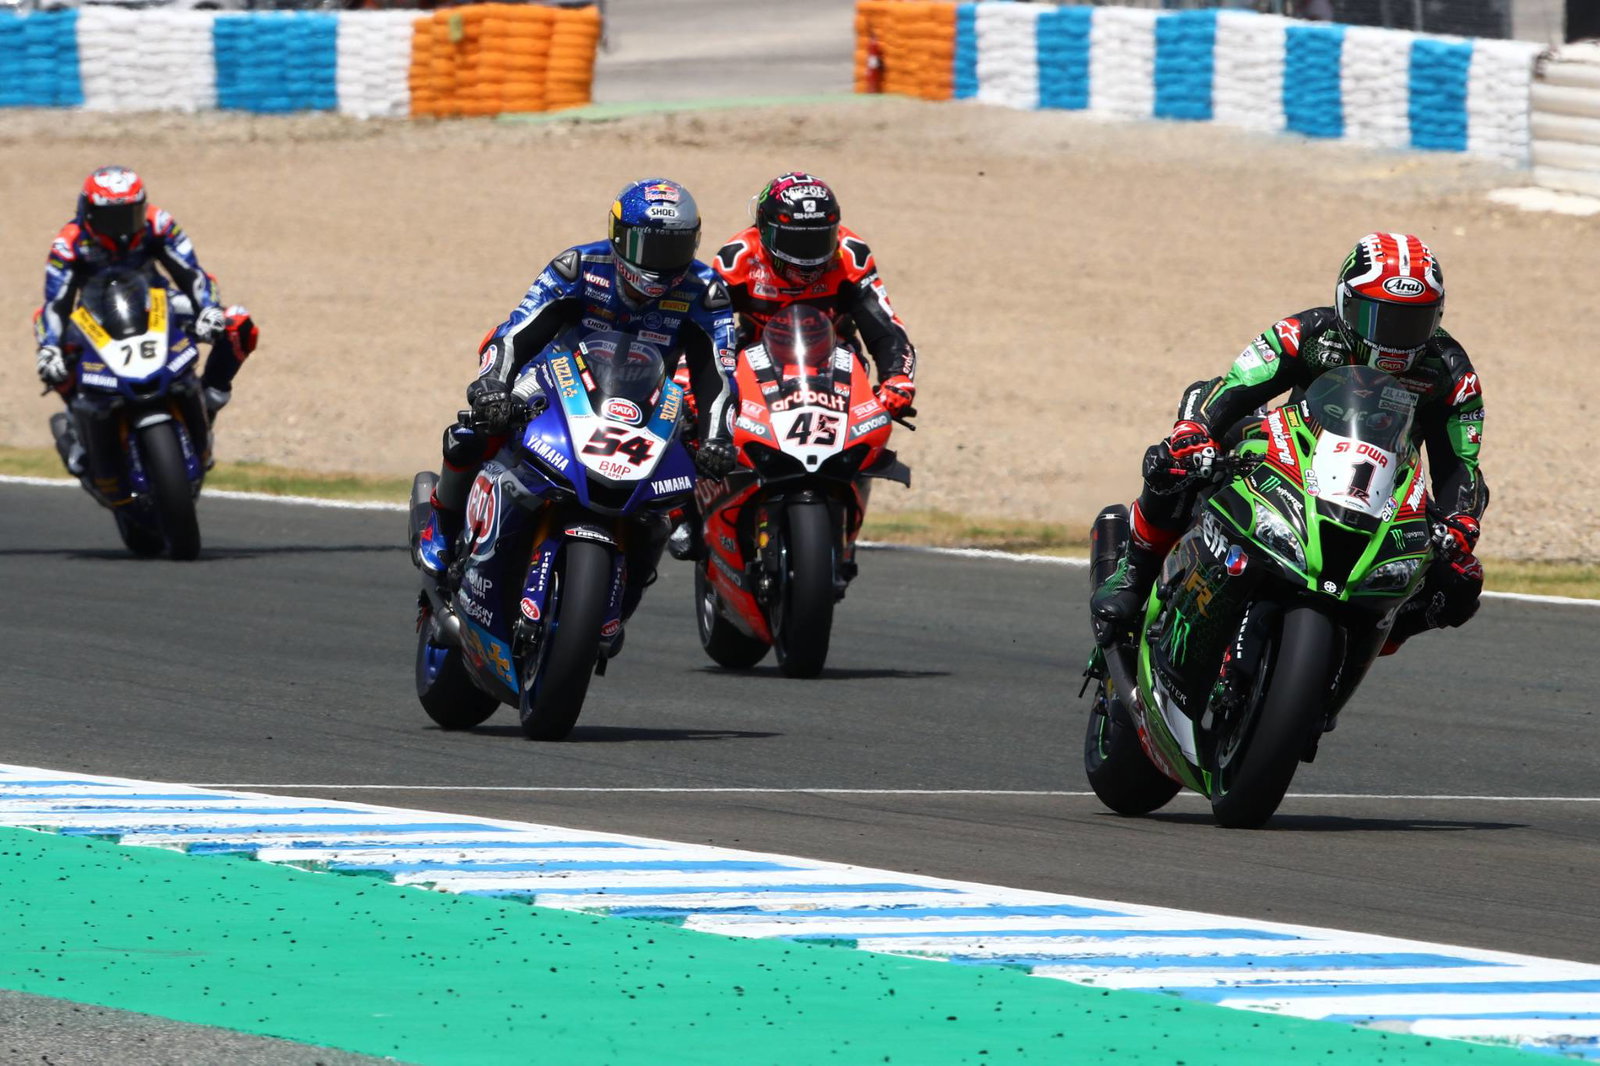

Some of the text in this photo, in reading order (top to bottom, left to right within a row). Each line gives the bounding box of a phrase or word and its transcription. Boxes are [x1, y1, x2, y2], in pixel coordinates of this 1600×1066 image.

[651, 208, 675, 217] SHOEI
[793, 211, 826, 219] SHARK
[583, 270, 610, 288] MOTUL
[1387, 280, 1421, 292] Arai
[120, 340, 158, 366] 76
[771, 390, 846, 411] aruba.it
[610, 405, 634, 417] PATA
[736, 416, 766, 436] novo
[785, 412, 840, 447] 45
[851, 416, 888, 437] Lenovo
[526, 435, 570, 472] YAMAHA
[581, 426, 655, 467] 54
[598, 460, 632, 477] BMP
[1349, 459, 1377, 492] 1
[650, 475, 693, 495] YAMAHA
[1381, 504, 1393, 523] elf
